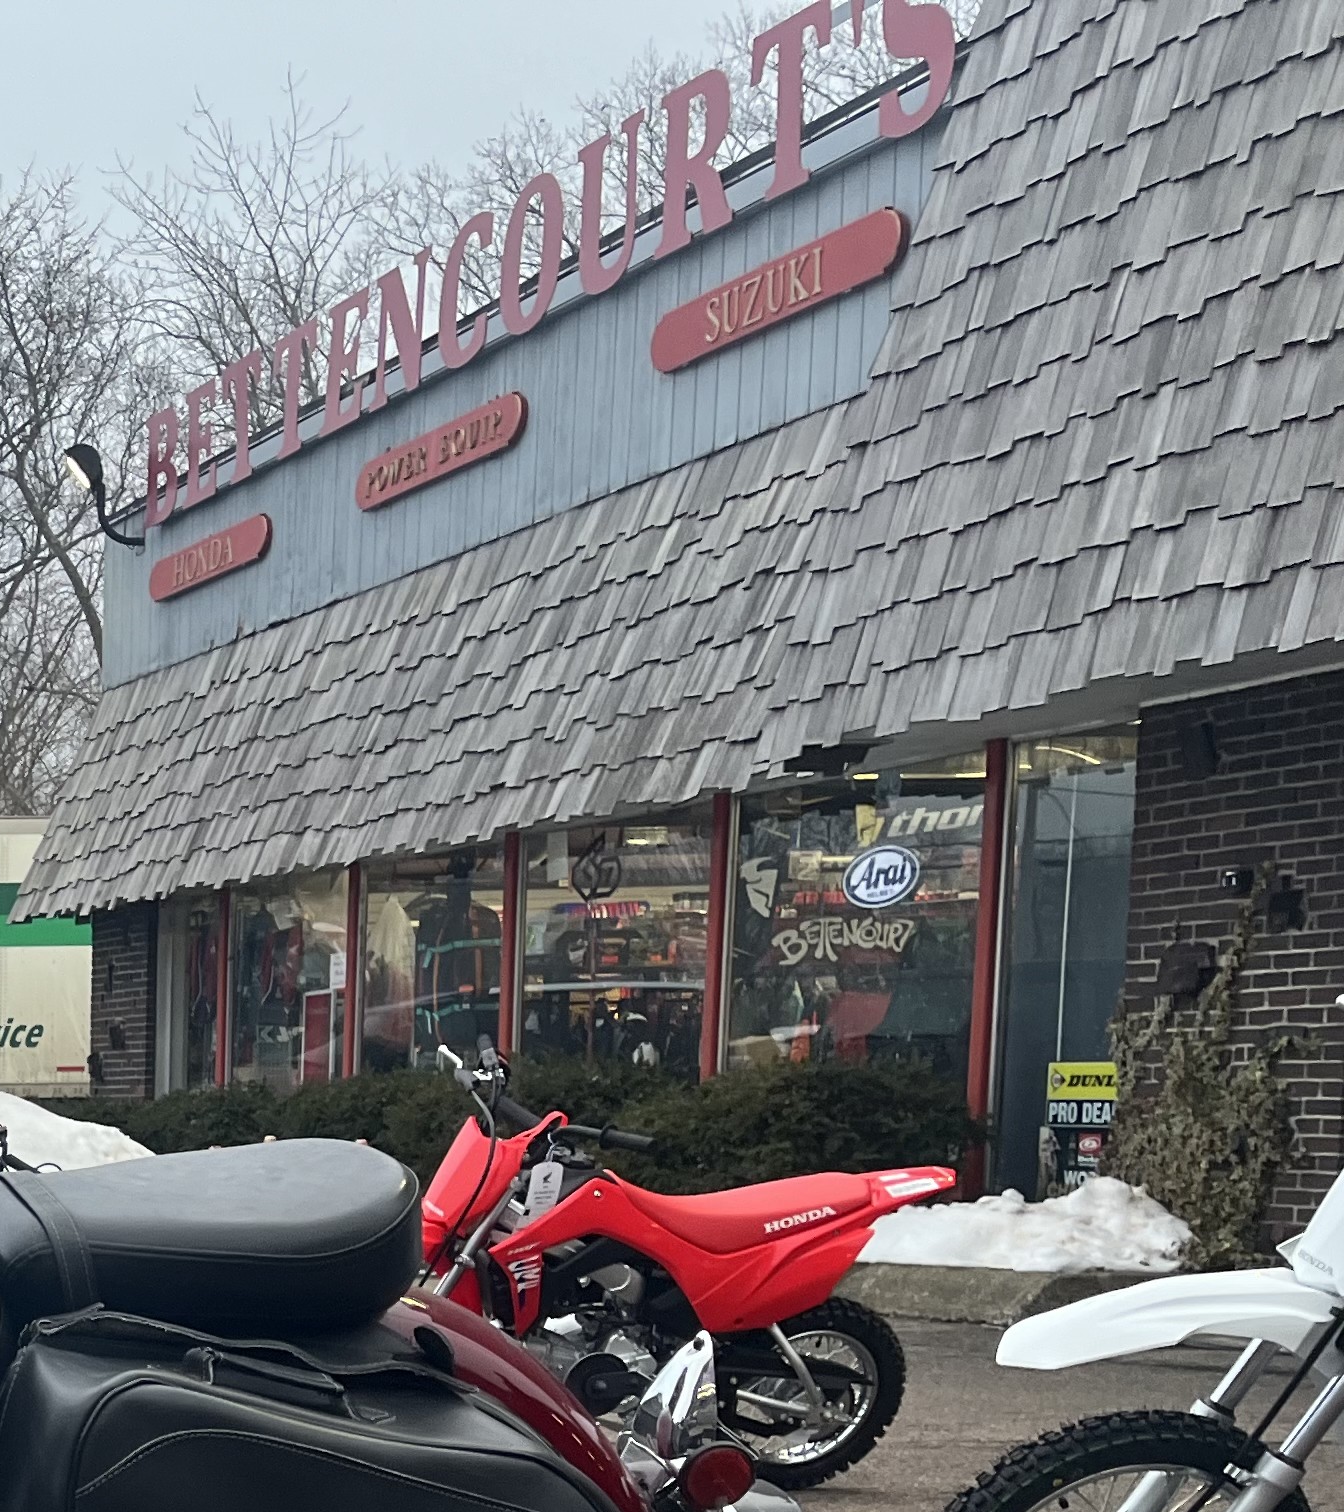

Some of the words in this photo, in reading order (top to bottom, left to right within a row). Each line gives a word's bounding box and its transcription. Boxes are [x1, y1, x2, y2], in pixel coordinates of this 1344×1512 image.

[143, 0, 955, 528] BETTENCOURT'S
[705, 246, 825, 344] SUZUKI
[365, 446, 428, 499] POWER
[173, 535, 233, 587] HONDA
[852, 854, 907, 891] Arai
[1048, 1102, 1078, 1123] PRO
[763, 1205, 838, 1235] HONDA
